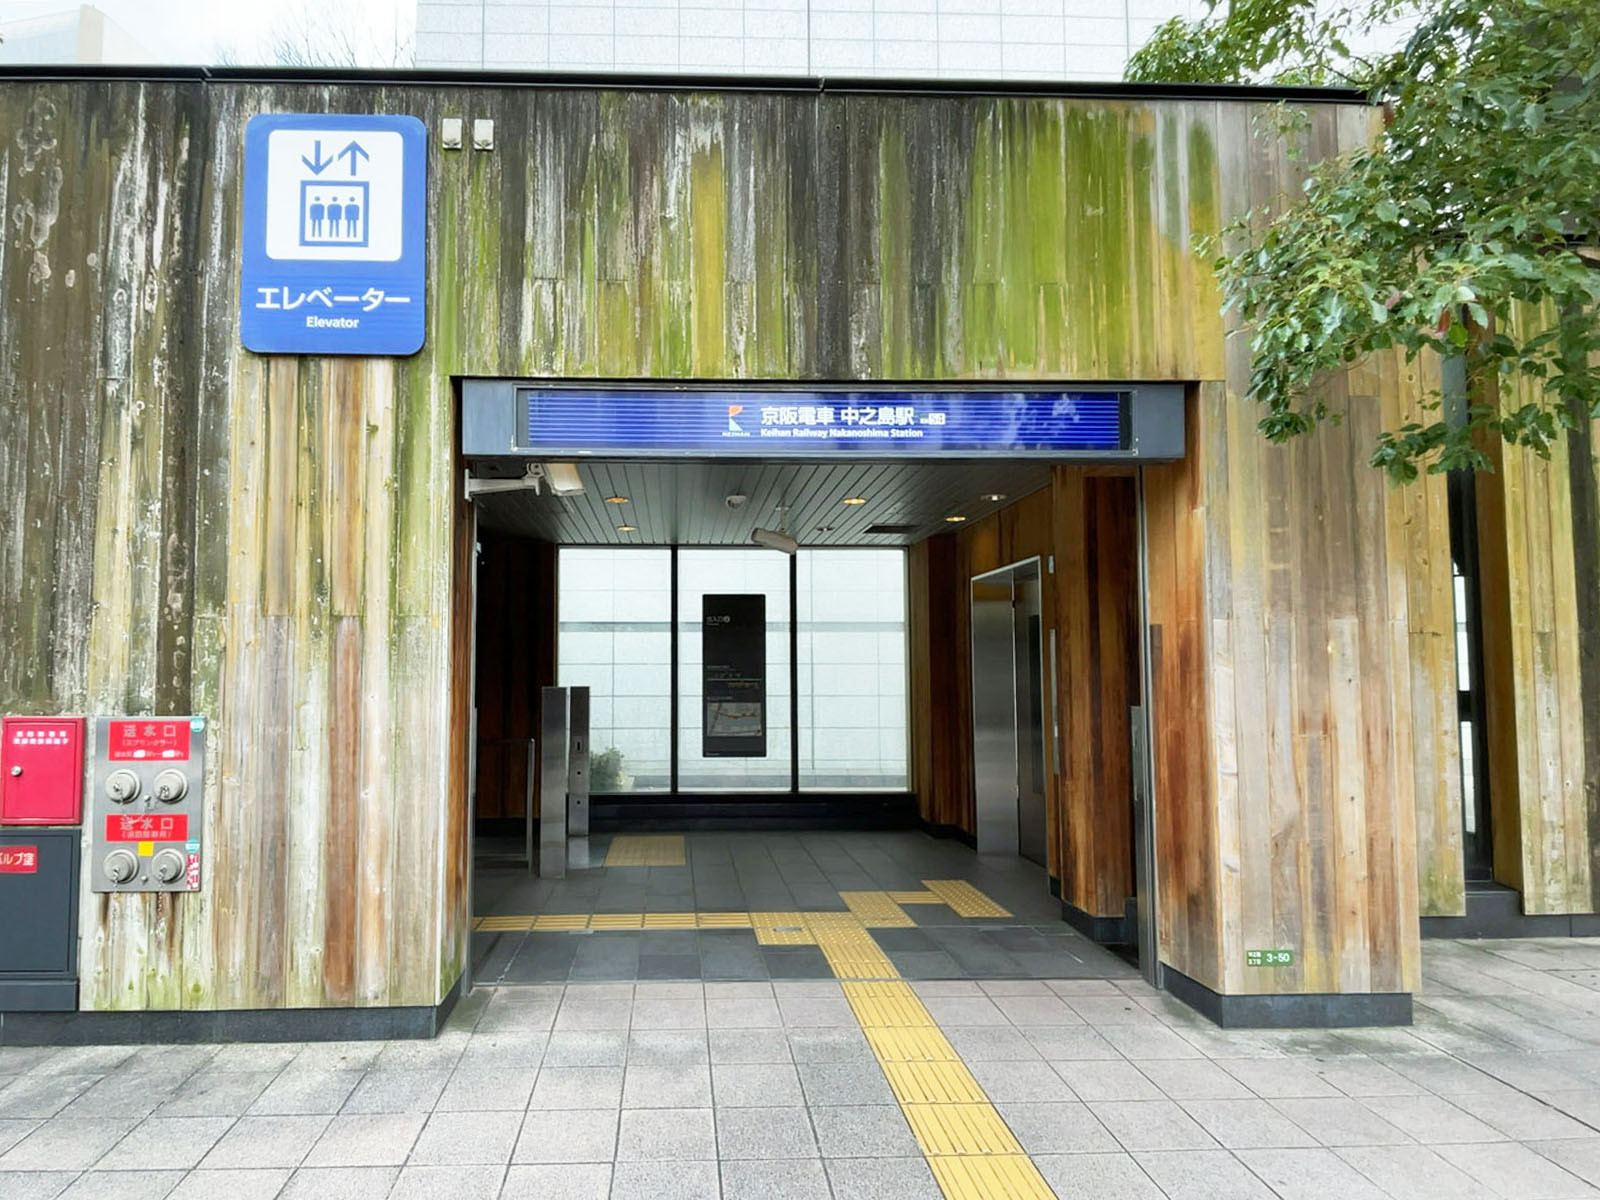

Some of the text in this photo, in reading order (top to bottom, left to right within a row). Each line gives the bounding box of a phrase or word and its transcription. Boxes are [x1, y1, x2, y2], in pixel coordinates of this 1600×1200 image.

[256, 286, 411, 312] エレベーター
[305, 315, 360, 328] Elevator
[761, 406, 835, 425] 京阪電車
[840, 406, 914, 425] 中之島駅
[761, 428, 923, 439] Keihan Railway Nakanoshima Station
[1266, 952, 1290, 963] 3-50
